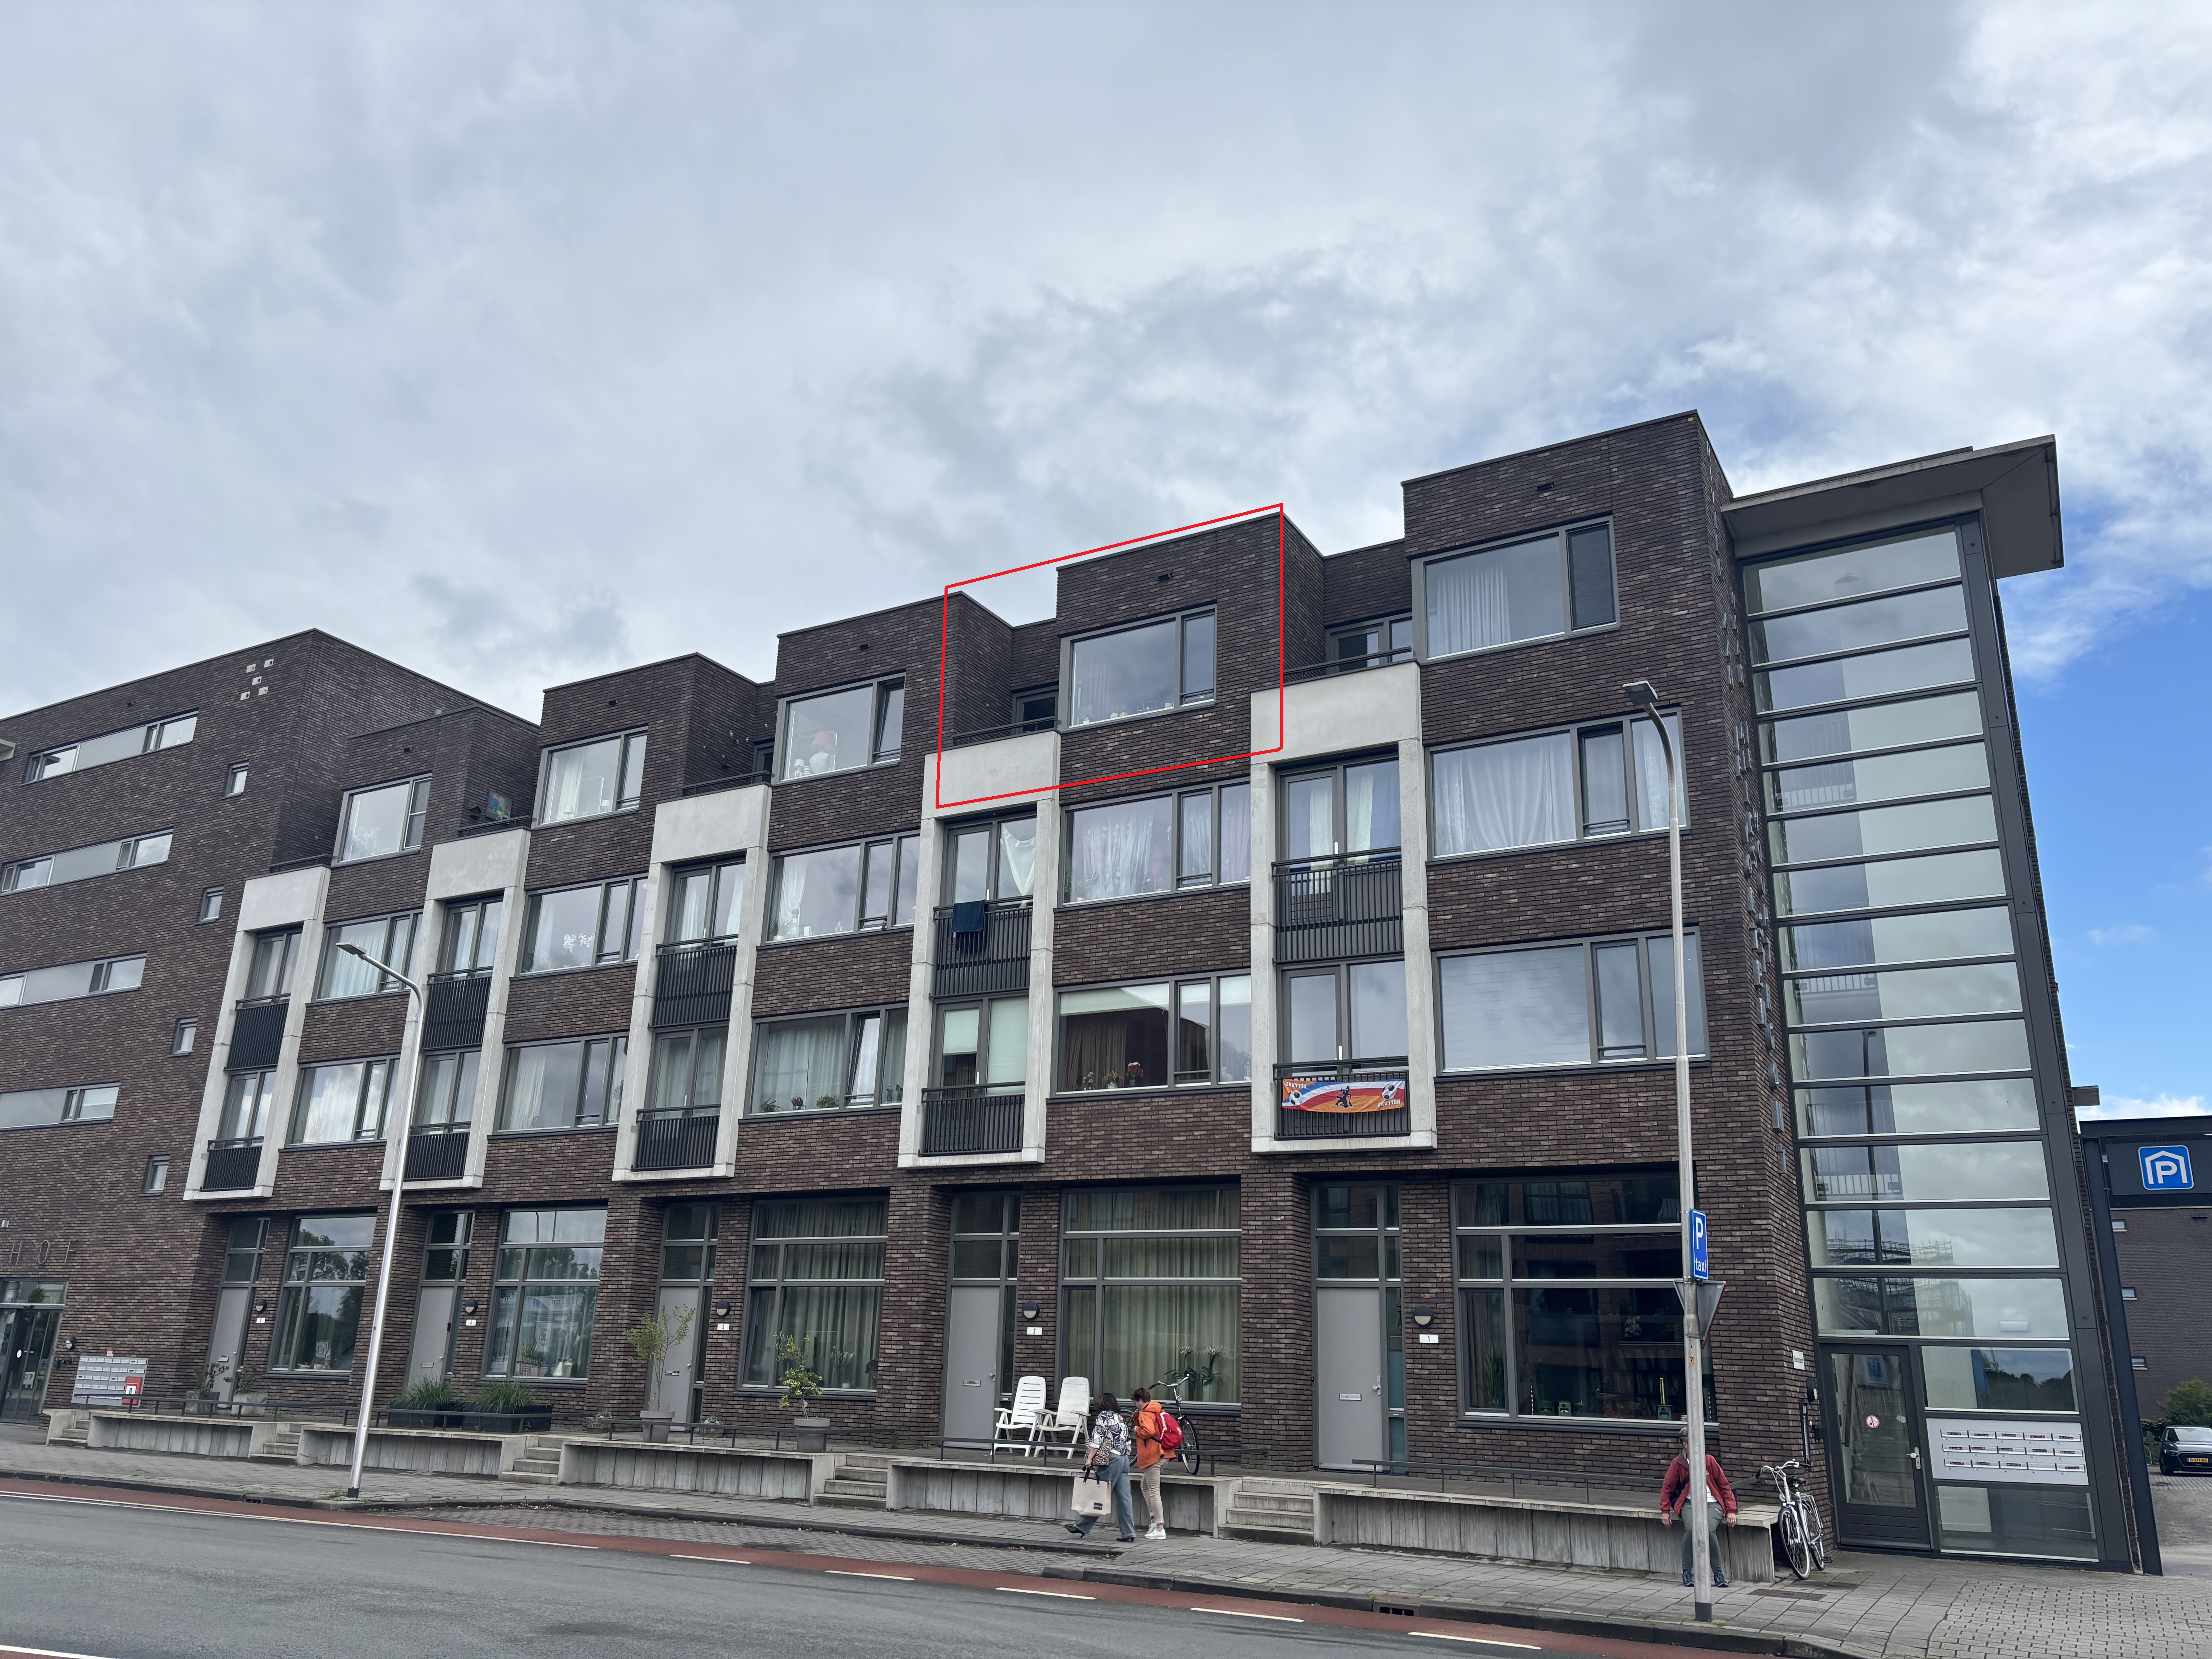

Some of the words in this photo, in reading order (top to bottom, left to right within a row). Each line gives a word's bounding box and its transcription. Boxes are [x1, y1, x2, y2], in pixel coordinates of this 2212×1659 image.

[2155, 1161, 2178, 1184] P
[1695, 1217, 1704, 1250] P
[9, 1240, 78, 1265] HOF
[1695, 1257, 1707, 1273] taxi
